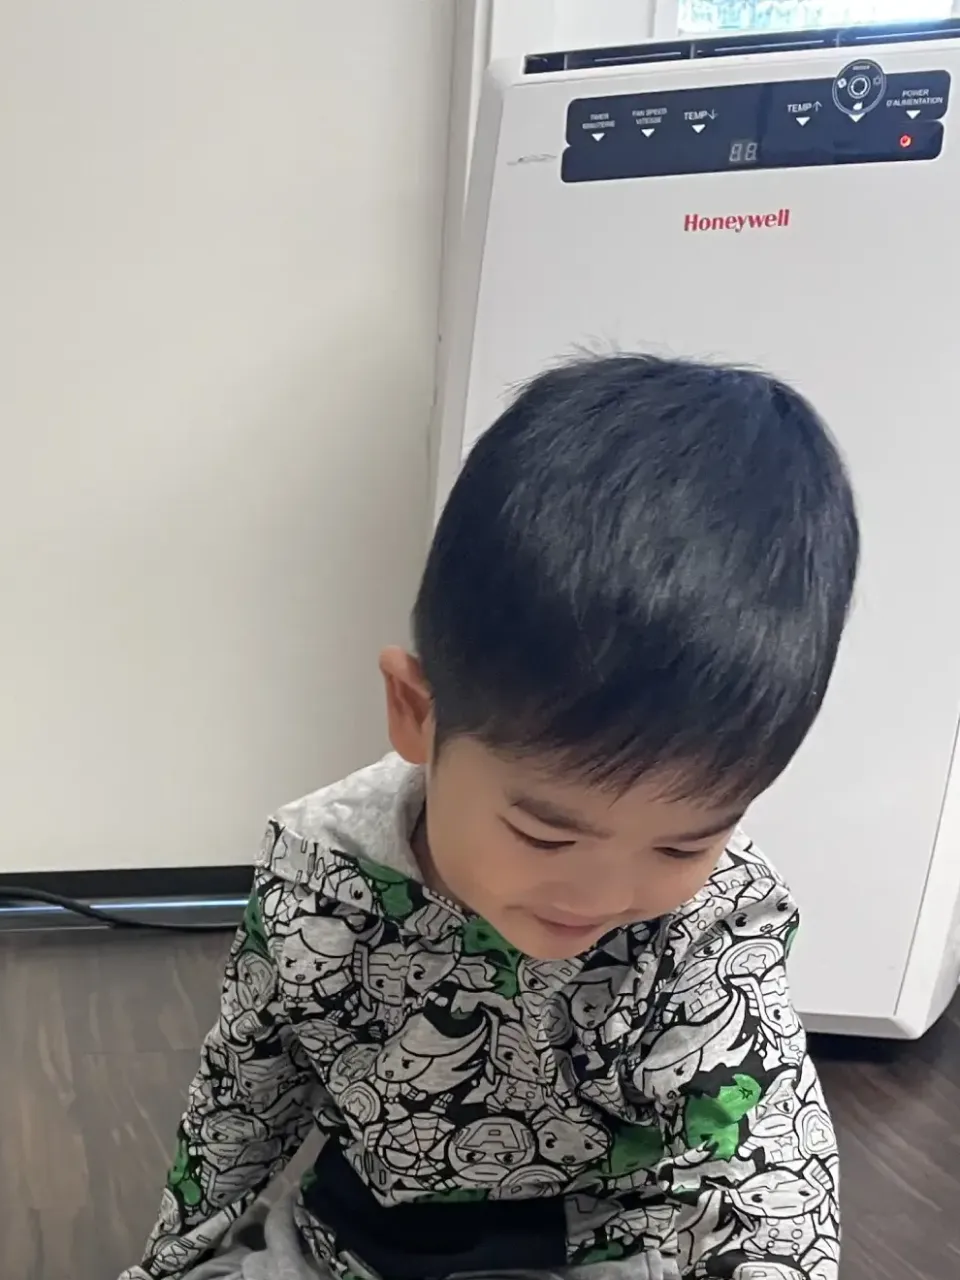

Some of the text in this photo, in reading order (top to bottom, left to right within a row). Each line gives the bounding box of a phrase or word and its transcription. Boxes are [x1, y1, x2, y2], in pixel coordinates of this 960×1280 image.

[787, 102, 812, 113] TEMP
[684, 110, 708, 120] TEMP
[684, 208, 790, 233] Honeywell
